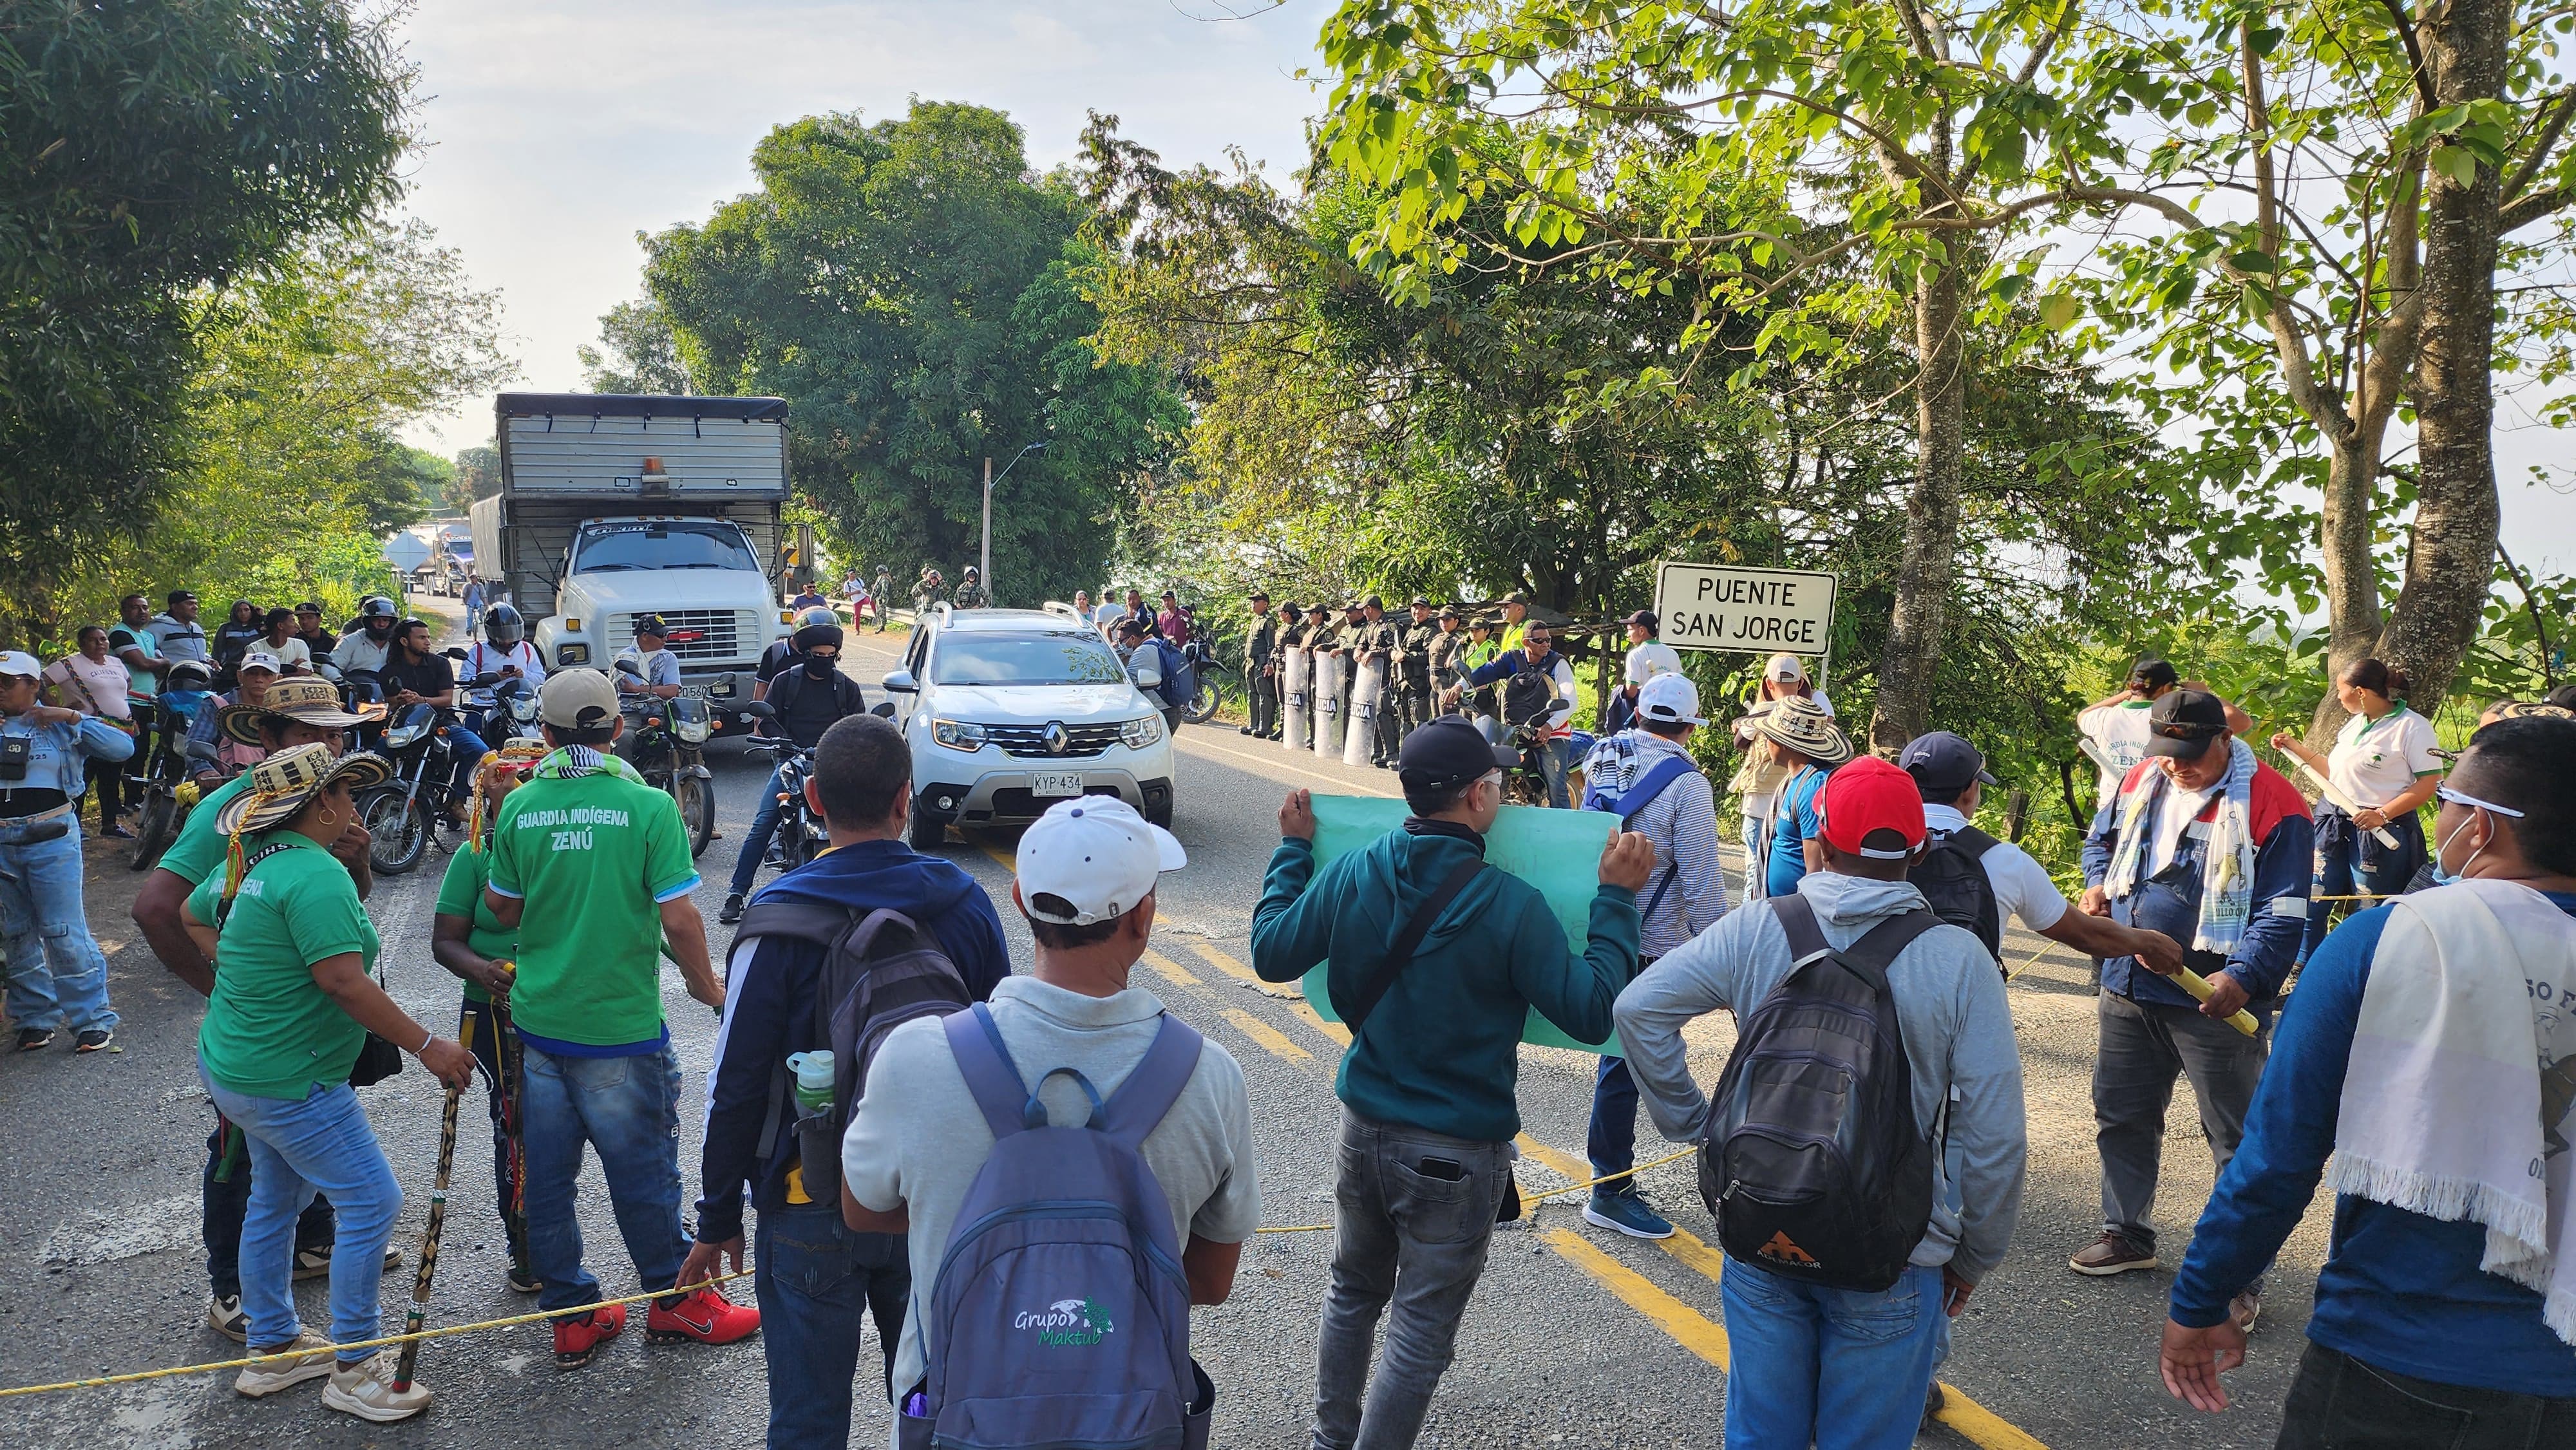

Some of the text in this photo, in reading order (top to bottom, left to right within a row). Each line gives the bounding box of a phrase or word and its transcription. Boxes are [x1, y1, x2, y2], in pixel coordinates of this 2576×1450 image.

[1698, 578, 1797, 607] PUENTE
[1672, 611, 1816, 643] SAN JORGE
[516, 805, 629, 830] GUARDIA INDÍGENA
[551, 825, 592, 851] ZENÚ
[1015, 1311, 1067, 1333] Grupo
[1038, 1328, 1102, 1347] Maktub
